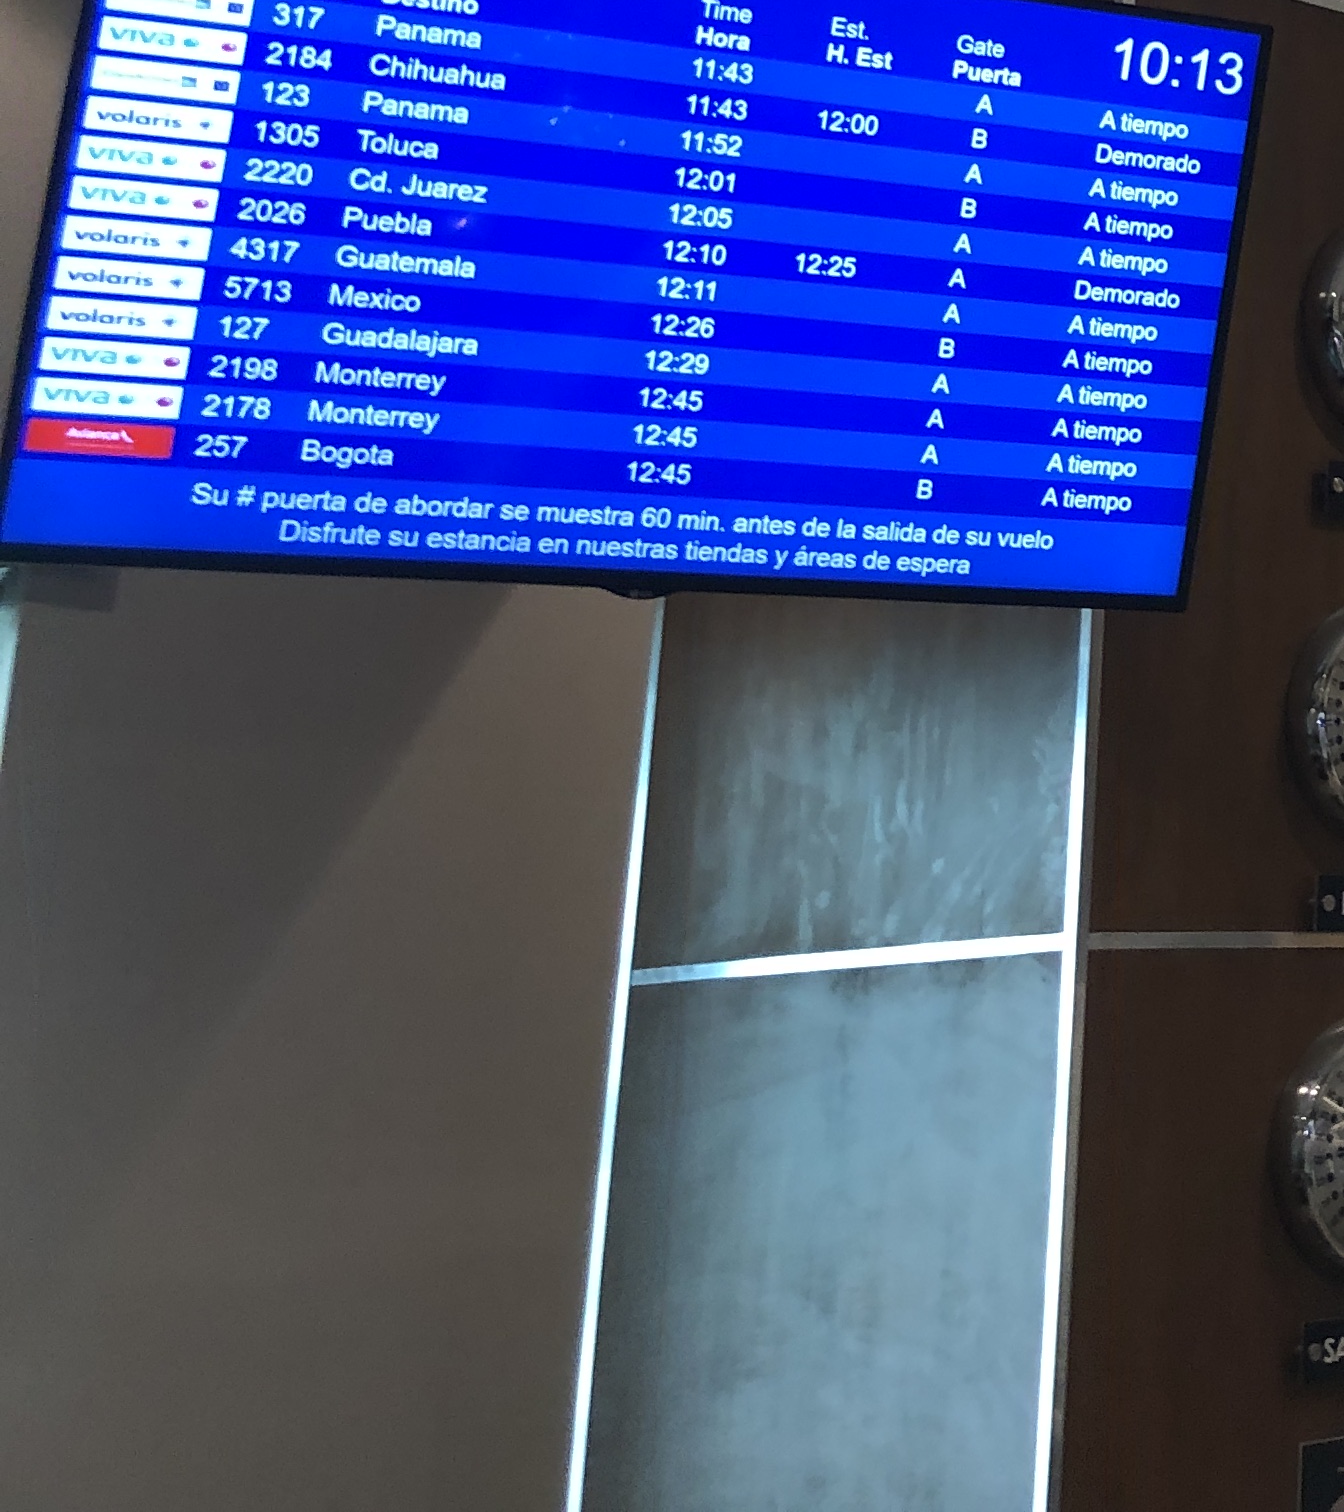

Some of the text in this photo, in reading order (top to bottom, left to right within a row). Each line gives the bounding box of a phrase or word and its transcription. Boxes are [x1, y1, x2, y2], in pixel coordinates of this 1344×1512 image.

[273, 3, 1189, 142] 317 Panama 11:43 A A tiempo
[696, 25, 751, 51] Hora
[826, 43, 849, 64] H.
[856, 46, 893, 70] Est
[952, 59, 1021, 87] Puerta
[830, 16, 869, 40] Est.
[957, 34, 1005, 58] Gate
[1114, 38, 1243, 95] 10:13
[262, 81, 1179, 209] 123 Panama 11:52 A A tiempo
[265, 42, 332, 71] 2184
[370, 53, 506, 90] Chihuahua
[688, 94, 748, 121] 11:43
[819, 110, 879, 136] 12:00
[971, 127, 988, 149] B
[1095, 142, 1201, 174] Demorado
[96, 109, 1174, 242] volaris 1305 Toluca 12:01 B A tiempo
[244, 158, 313, 186] 2220
[350, 167, 392, 193] Cd.
[401, 174, 488, 203] Juarez
[669, 203, 733, 229] 12:05
[953, 233, 971, 254] A
[1078, 246, 1095, 266] A
[1100, 249, 1168, 276] tiempo
[74, 228, 1158, 344] volaris 4317 Guatemala 12:11 A A tiempo
[237, 197, 306, 225] 2026
[343, 206, 432, 236] Puebla
[663, 240, 727, 266] 12:10
[796, 253, 856, 278] 12:25
[948, 268, 966, 289] A
[1074, 280, 1180, 309] Demorado
[59, 308, 1148, 412] volaris 127 Guadalajara 12:29 A A tiempo
[66, 268, 1153, 378] volaris 5713 Mexico 12:26 B A tiempo
[201, 394, 271, 420] 2178
[308, 399, 440, 434] Monterrey
[633, 424, 698, 448] 12:45
[920, 444, 938, 465] A
[1046, 452, 1064, 473] A
[1068, 455, 1137, 481] tiempo
[208, 354, 278, 381] 2198
[315, 361, 446, 396] Monterrey
[640, 387, 703, 412] 12:45
[926, 408, 944, 429] A
[1051, 418, 1069, 438] A
[1073, 419, 1142, 446] tiempo
[192, 482, 1054, 550] Su # puerta de abordar se muestra 60 min. antes de la salida de su vuelo
[195, 434, 1132, 515] 257 Bogota 12:45 B A tiempo
[279, 519, 970, 577] Disfrute su estancia en nuestras tiendas y áreas de espera
